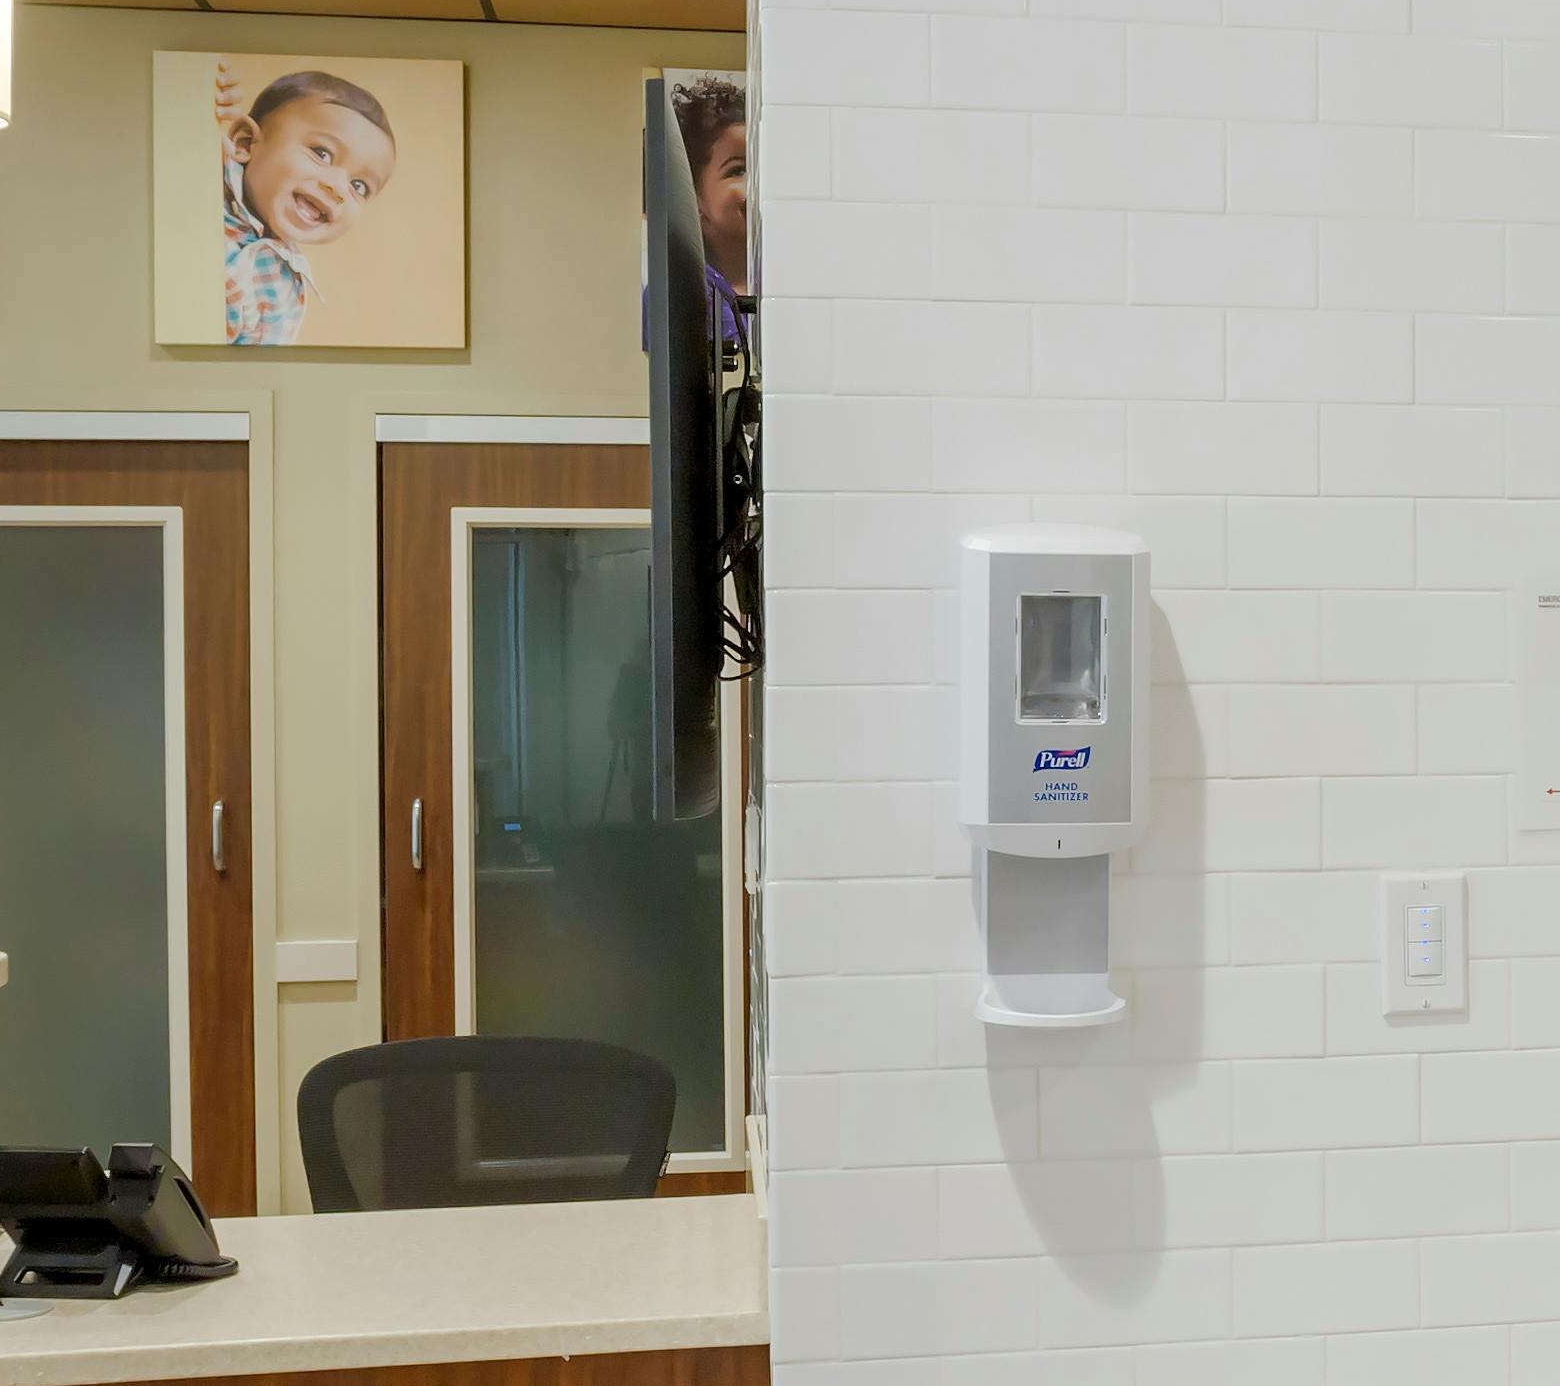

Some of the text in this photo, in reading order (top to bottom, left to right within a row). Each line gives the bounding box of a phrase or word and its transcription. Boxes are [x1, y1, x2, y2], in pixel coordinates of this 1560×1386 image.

[1040, 752, 1086, 768] Purell
[1045, 782, 1078, 791] HAND
[1034, 792, 1089, 801] SANITIZER
